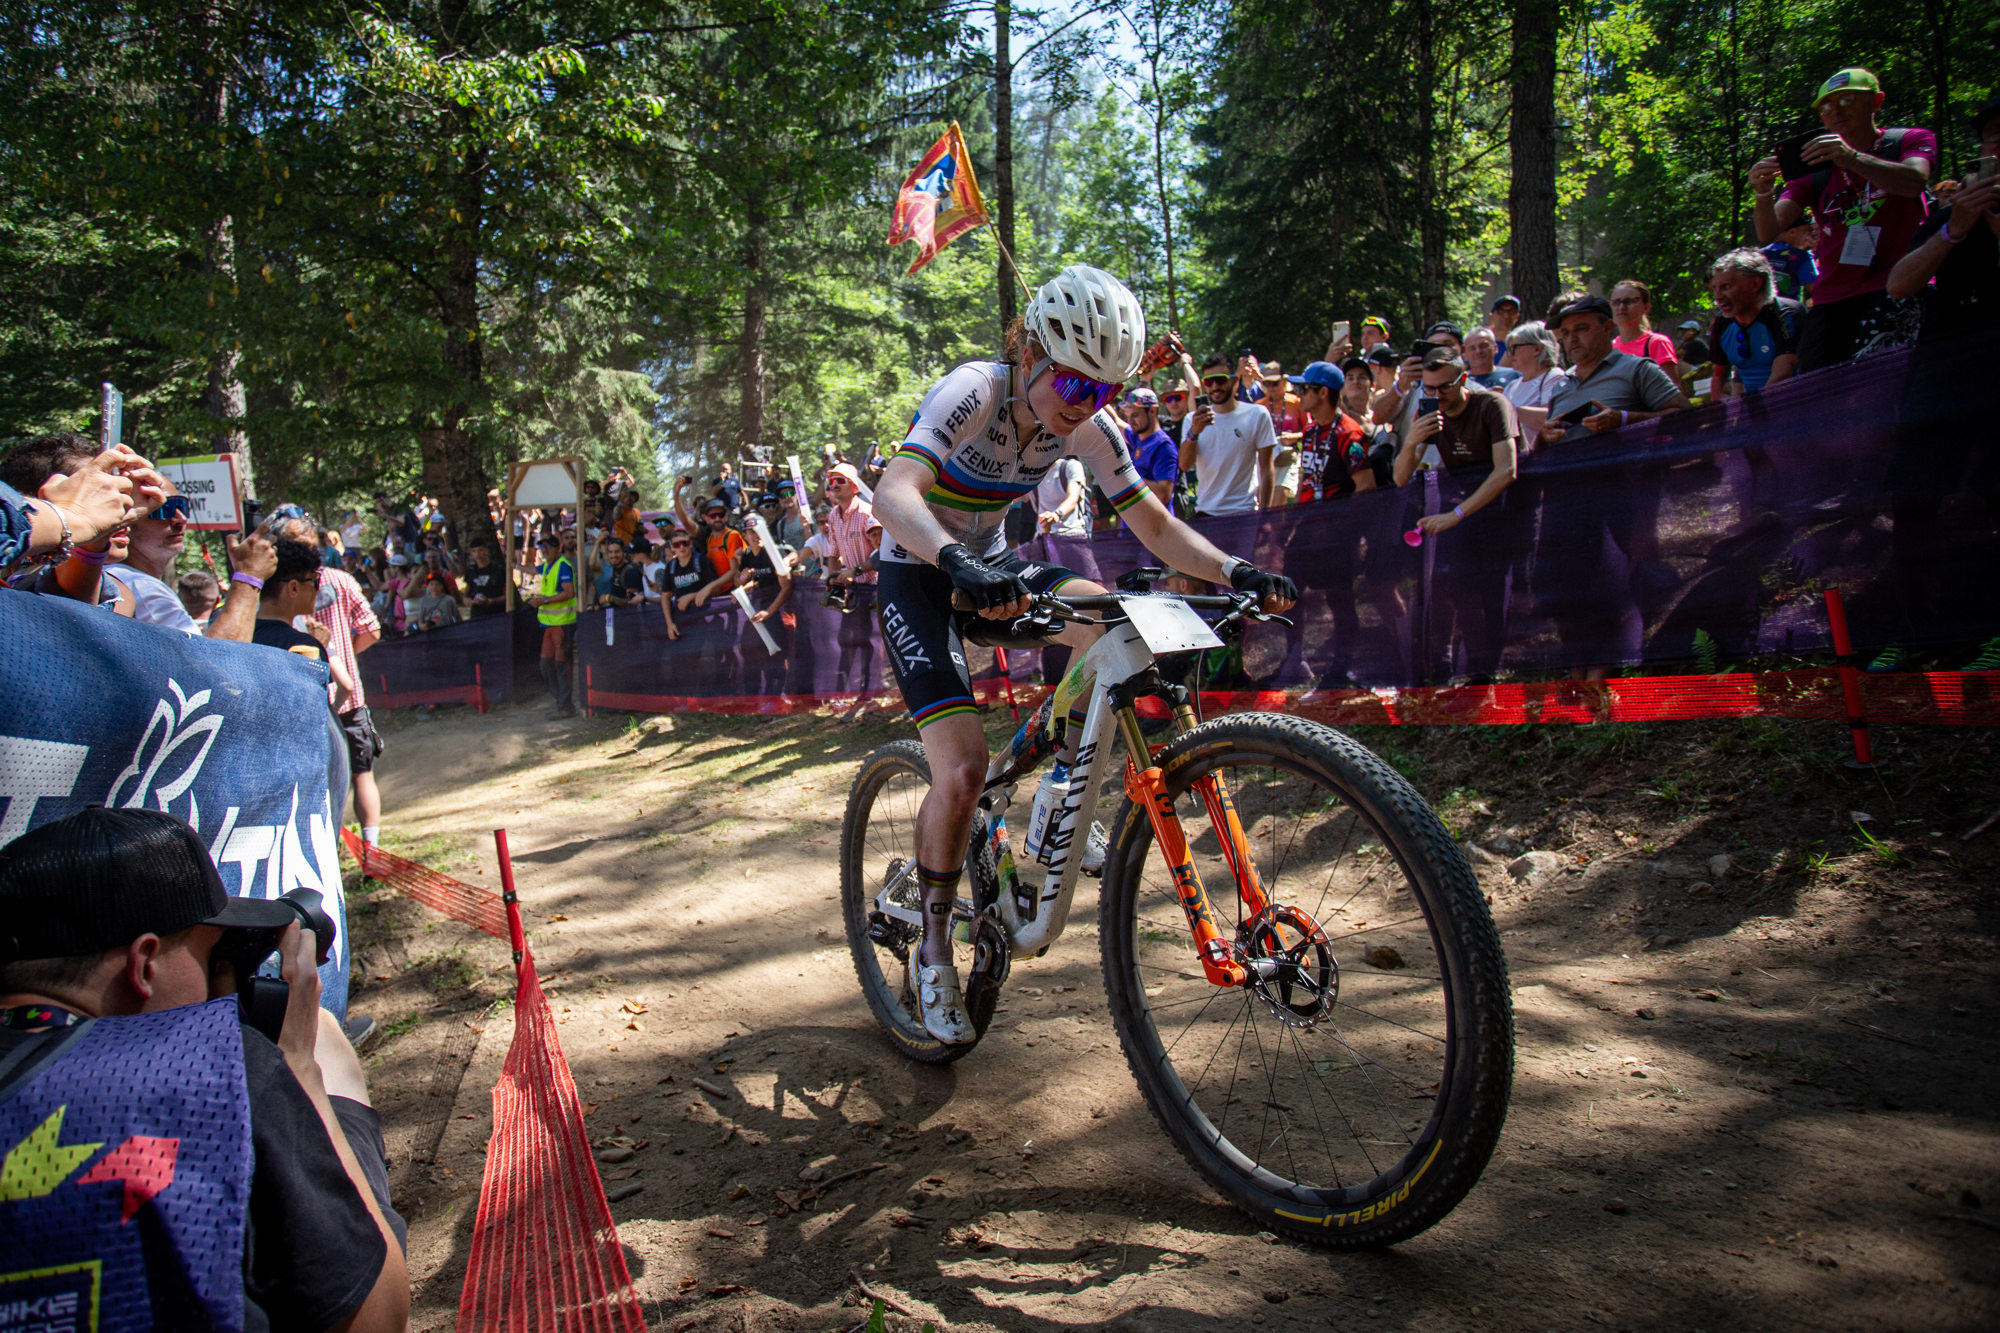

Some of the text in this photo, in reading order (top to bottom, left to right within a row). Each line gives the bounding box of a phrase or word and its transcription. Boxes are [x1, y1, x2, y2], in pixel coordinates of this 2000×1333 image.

[945, 388, 982, 435] FENIX
[989, 426, 1008, 447] UCI
[960, 444, 1004, 474] FENIX
[174, 480, 216, 494] ROSSING
[882, 602, 931, 671] FENIX
[1034, 803, 1048, 842] ELITE
[1171, 861, 1214, 931] FOX
[1322, 1179, 1411, 1227] PIRELLI
